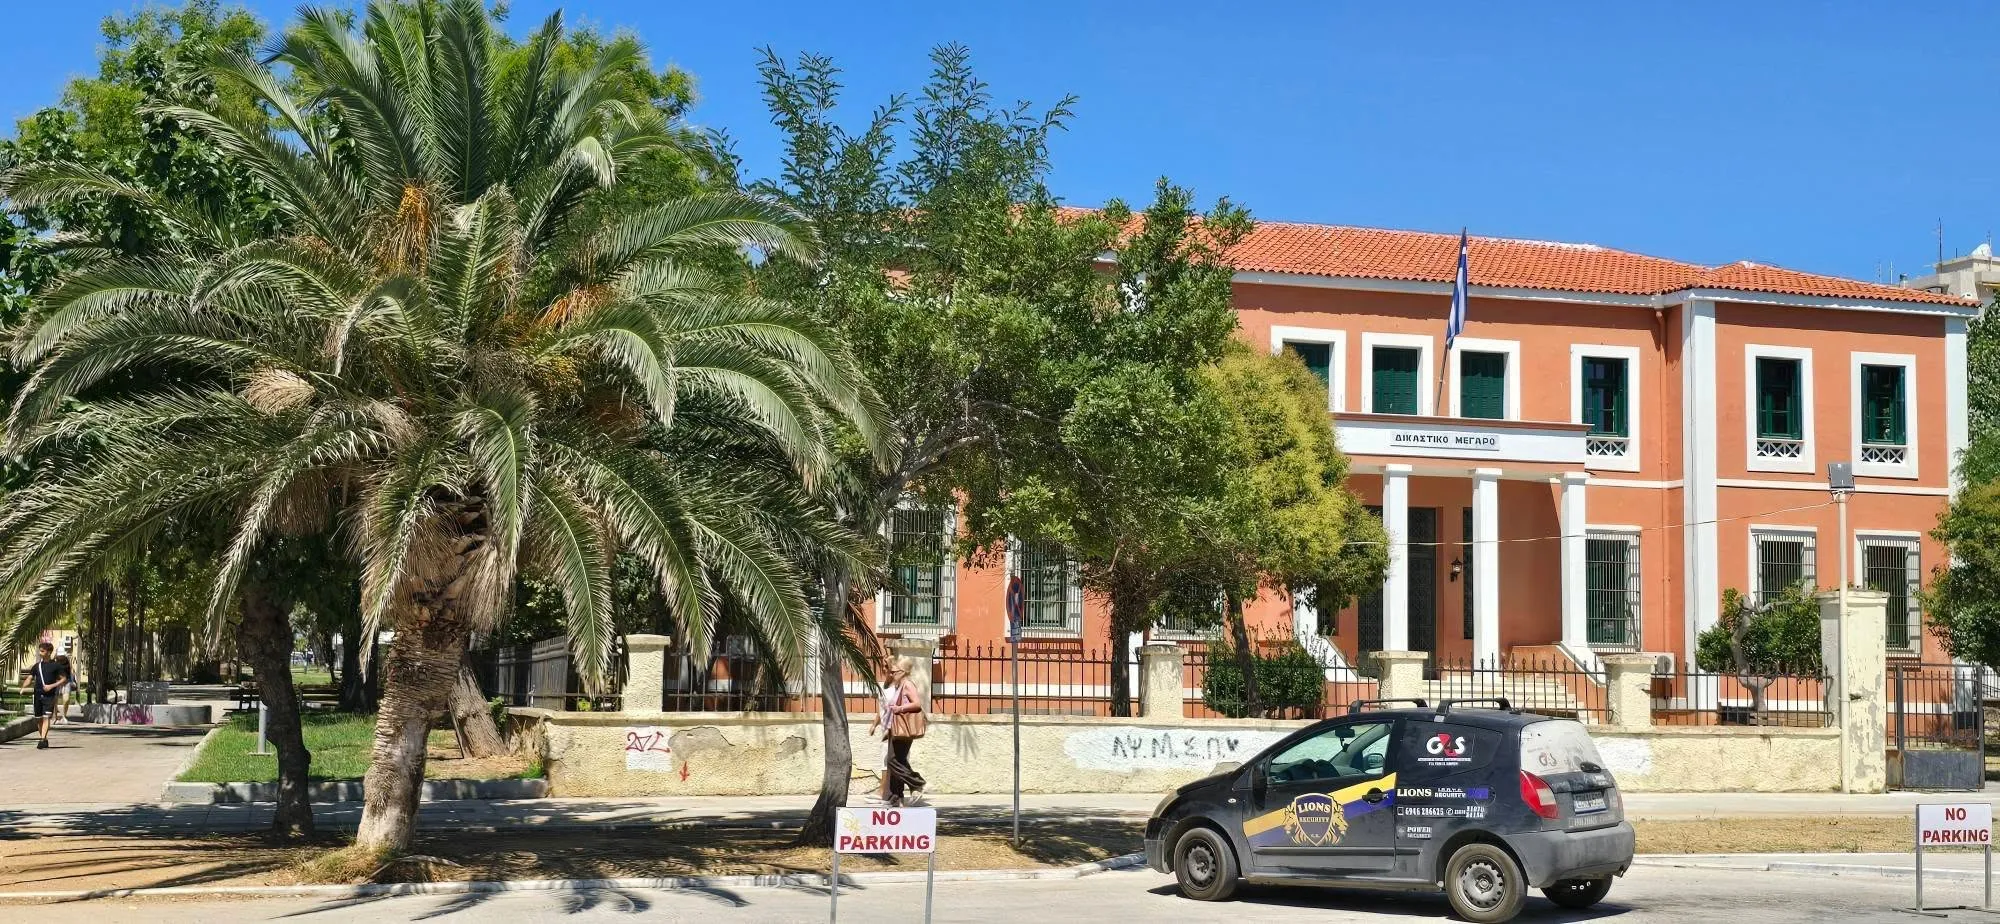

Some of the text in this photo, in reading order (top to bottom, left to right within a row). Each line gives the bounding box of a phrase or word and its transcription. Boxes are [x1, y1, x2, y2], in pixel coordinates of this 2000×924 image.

[1395, 434, 1495, 446] ΔΙΚΑΣΤΙΚΟ ΜΕΓΑΡΟ
[1396, 788, 1432, 797] LIONS
[1297, 802, 1331, 814] LIONS
[1945, 807, 1967, 821] NO
[872, 810, 901, 826] NO
[839, 834, 930, 851] PARKING
[1922, 829, 1989, 843] PARKING
